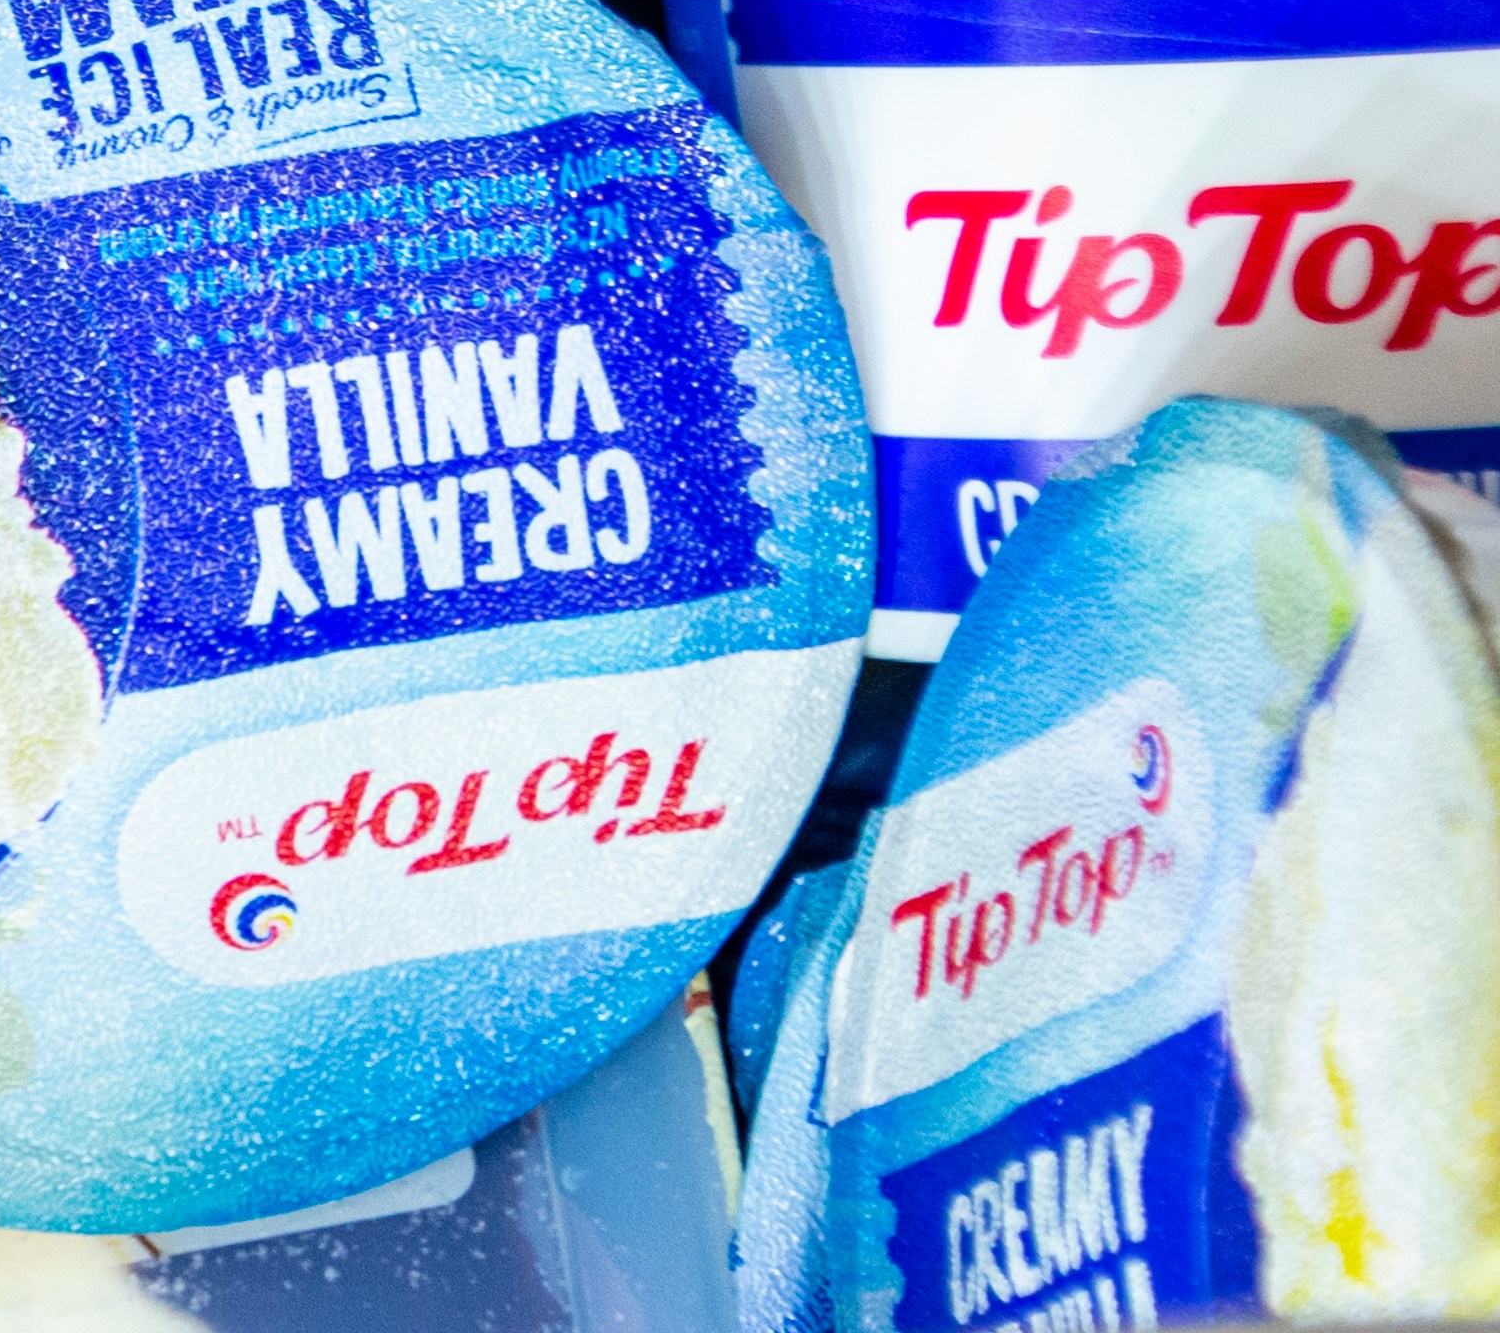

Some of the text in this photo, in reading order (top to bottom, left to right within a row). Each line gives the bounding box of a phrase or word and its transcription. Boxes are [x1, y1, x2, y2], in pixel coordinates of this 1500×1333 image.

[27, 39, 167, 139] ICE
[53, 112, 198, 170] Creamy
[236, 70, 393, 129] Smooth
[904, 183, 1185, 360] Tip
[226, 323, 625, 490] VANILLA
[243, 447, 653, 627] CREAMY
[273, 731, 727, 877] Tip Top
[890, 824, 1148, 1001] Tip Top
[945, 1103, 1153, 1328] CREAMY
